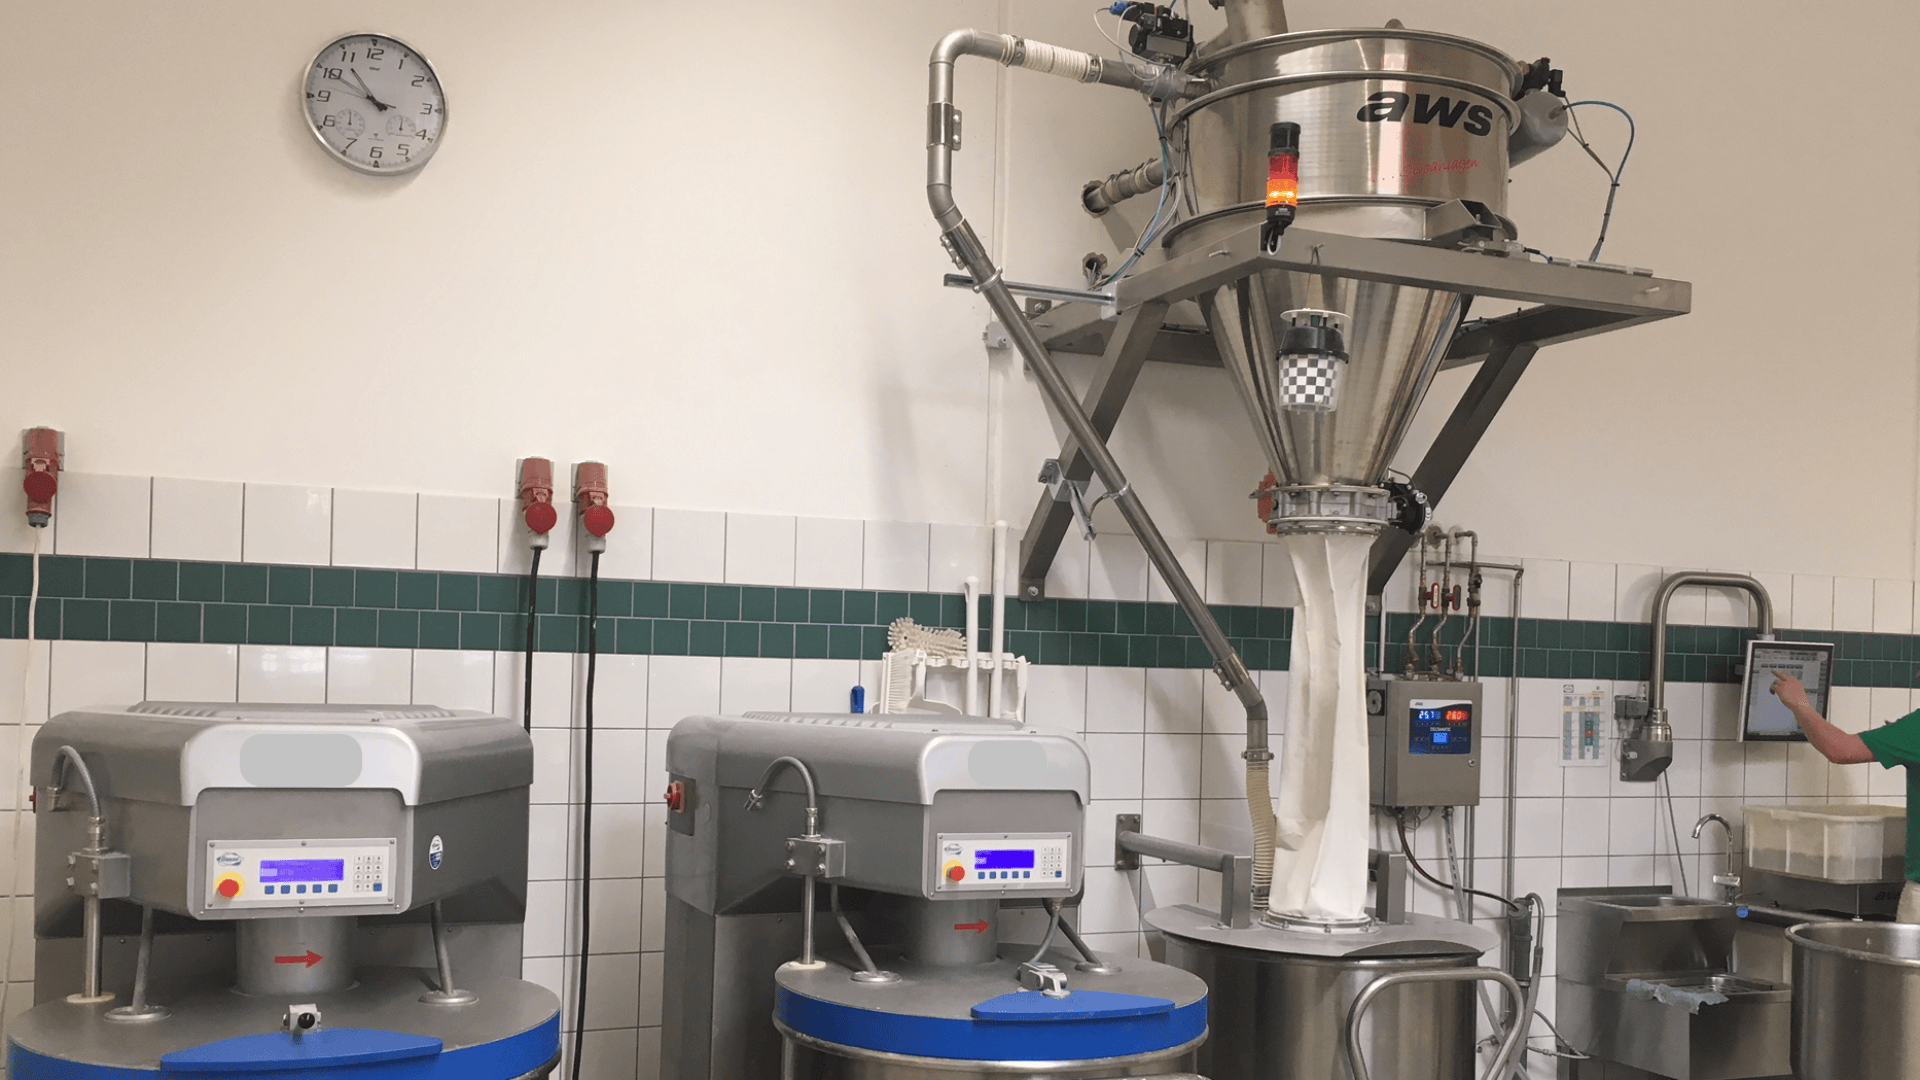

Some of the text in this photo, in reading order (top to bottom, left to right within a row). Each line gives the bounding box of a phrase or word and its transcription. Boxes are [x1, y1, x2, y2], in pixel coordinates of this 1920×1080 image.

[341, 50, 356, 63] 11
[366, 47, 385, 61] 12
[398, 59, 404, 70] 1
[322, 67, 343, 80] 10
[411, 74, 425, 88] 2
[316, 90, 331, 103] 9
[419, 102, 433, 115] 3
[1356, 91, 1493, 137] aws
[415, 129, 427, 141] 4
[346, 137, 358, 150] 7
[396, 143, 411, 156] 5
[369, 146, 384, 159] 6
